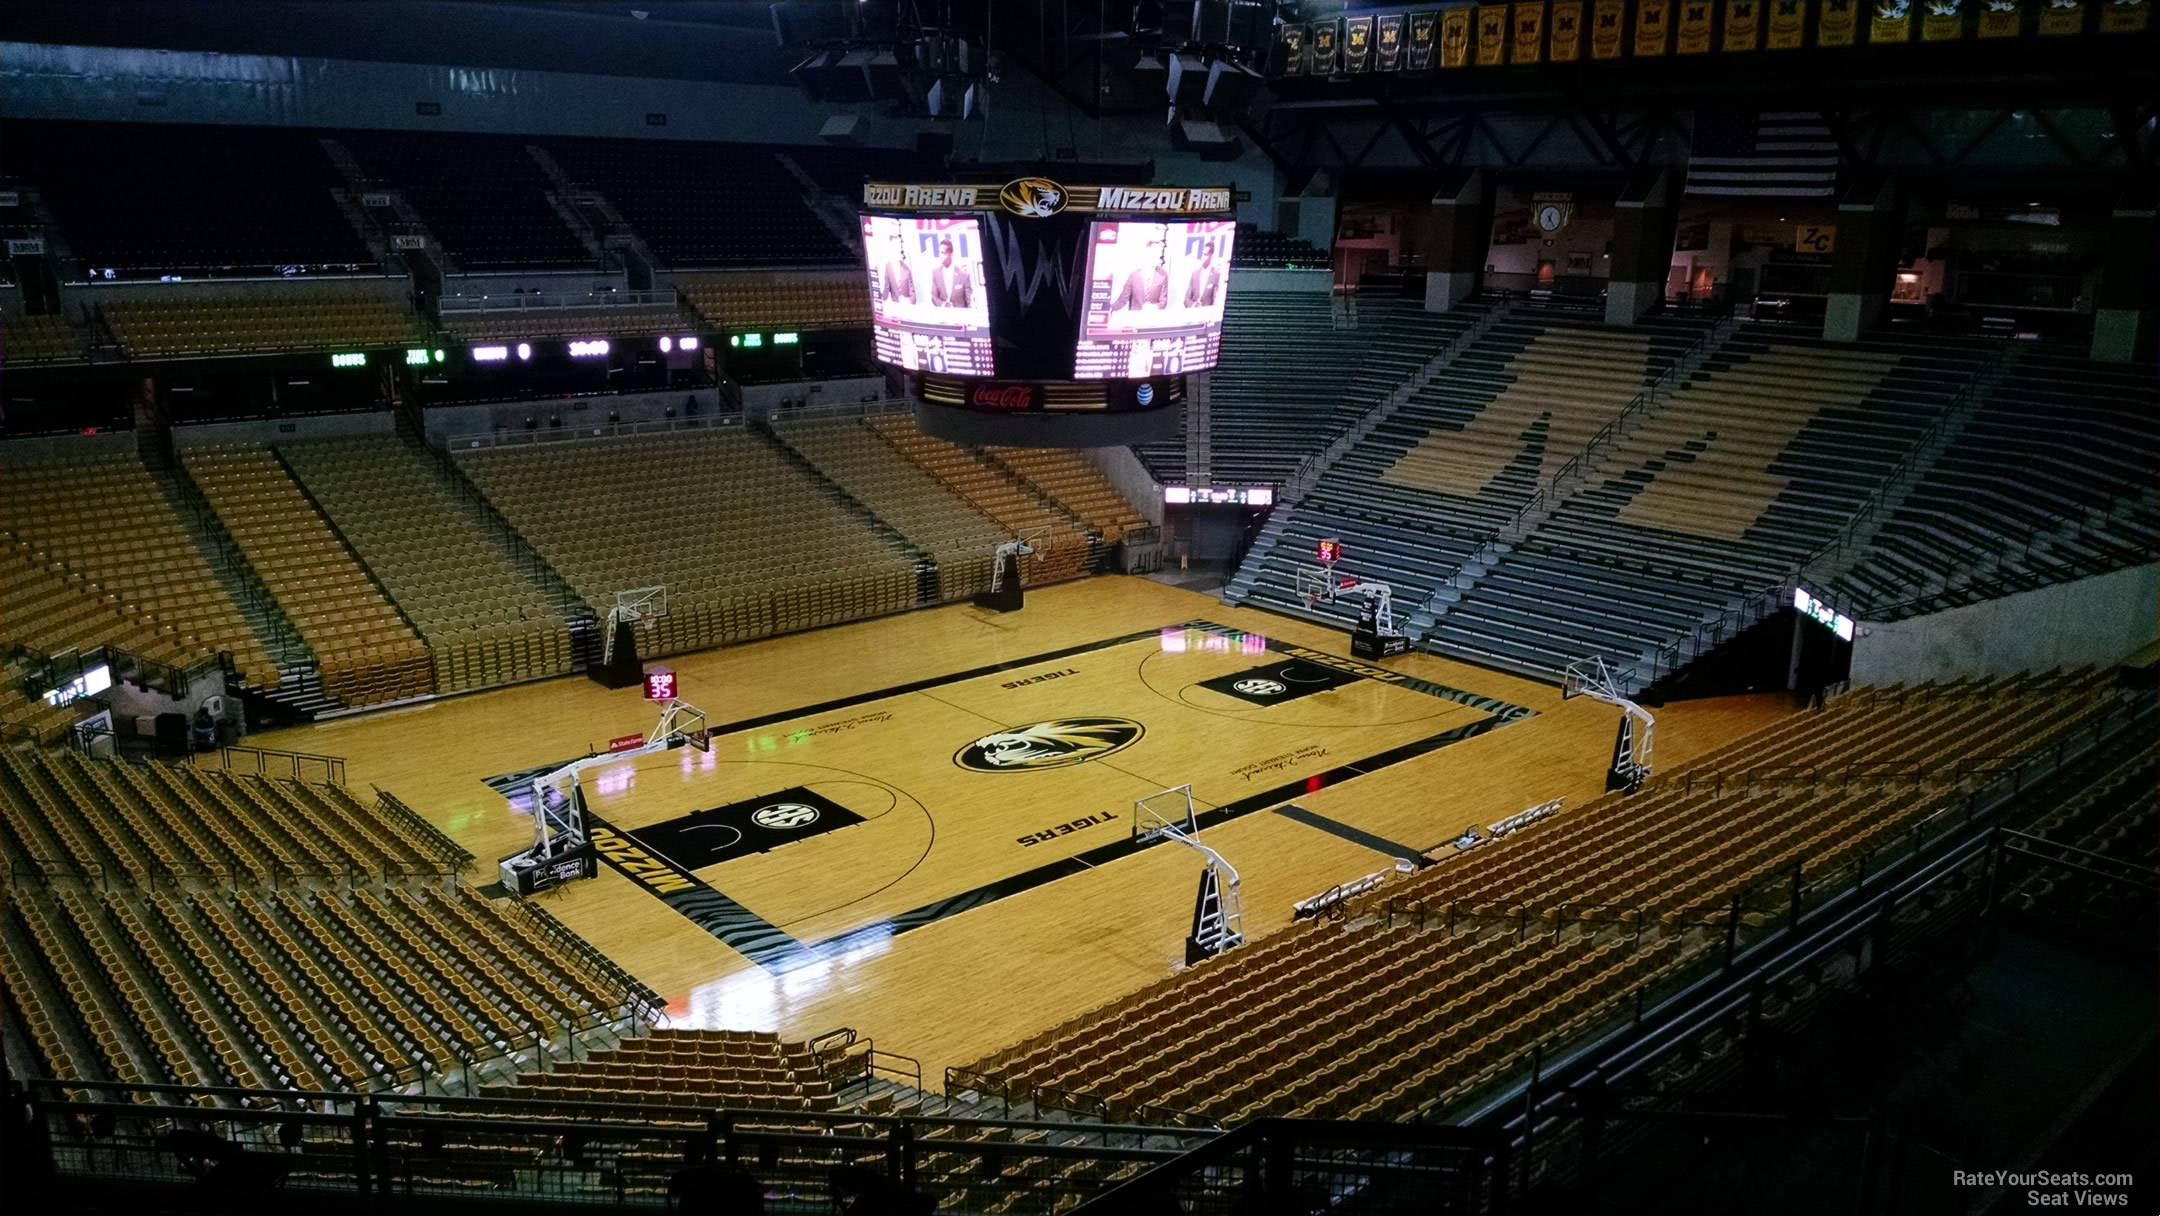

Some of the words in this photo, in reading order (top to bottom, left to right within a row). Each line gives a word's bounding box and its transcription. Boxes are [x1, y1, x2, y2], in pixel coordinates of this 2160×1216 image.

[1600, 14, 1616, 27] M
[1644, 10, 1661, 24] M
[1687, 7, 1705, 21] M
[1484, 23, 1498, 36] M
[1521, 20, 1536, 33] M
[1558, 17, 1574, 30] M
[1351, 32, 1365, 45] M
[1382, 30, 1397, 43] M
[904, 185, 979, 206] ARENA
[1097, 187, 1186, 209] MIZZOU
[1187, 188, 1230, 209] ARENA
[1283, 648, 1407, 681] MIZZOU
[1001, 668, 1080, 690] TIGERS
[651, 682, 671, 698] 35
[756, 805, 815, 827] SEC
[1016, 811, 1119, 847] TIGERS
[590, 828, 697, 894] MIZZOU
[559, 868, 581, 880] Bank
